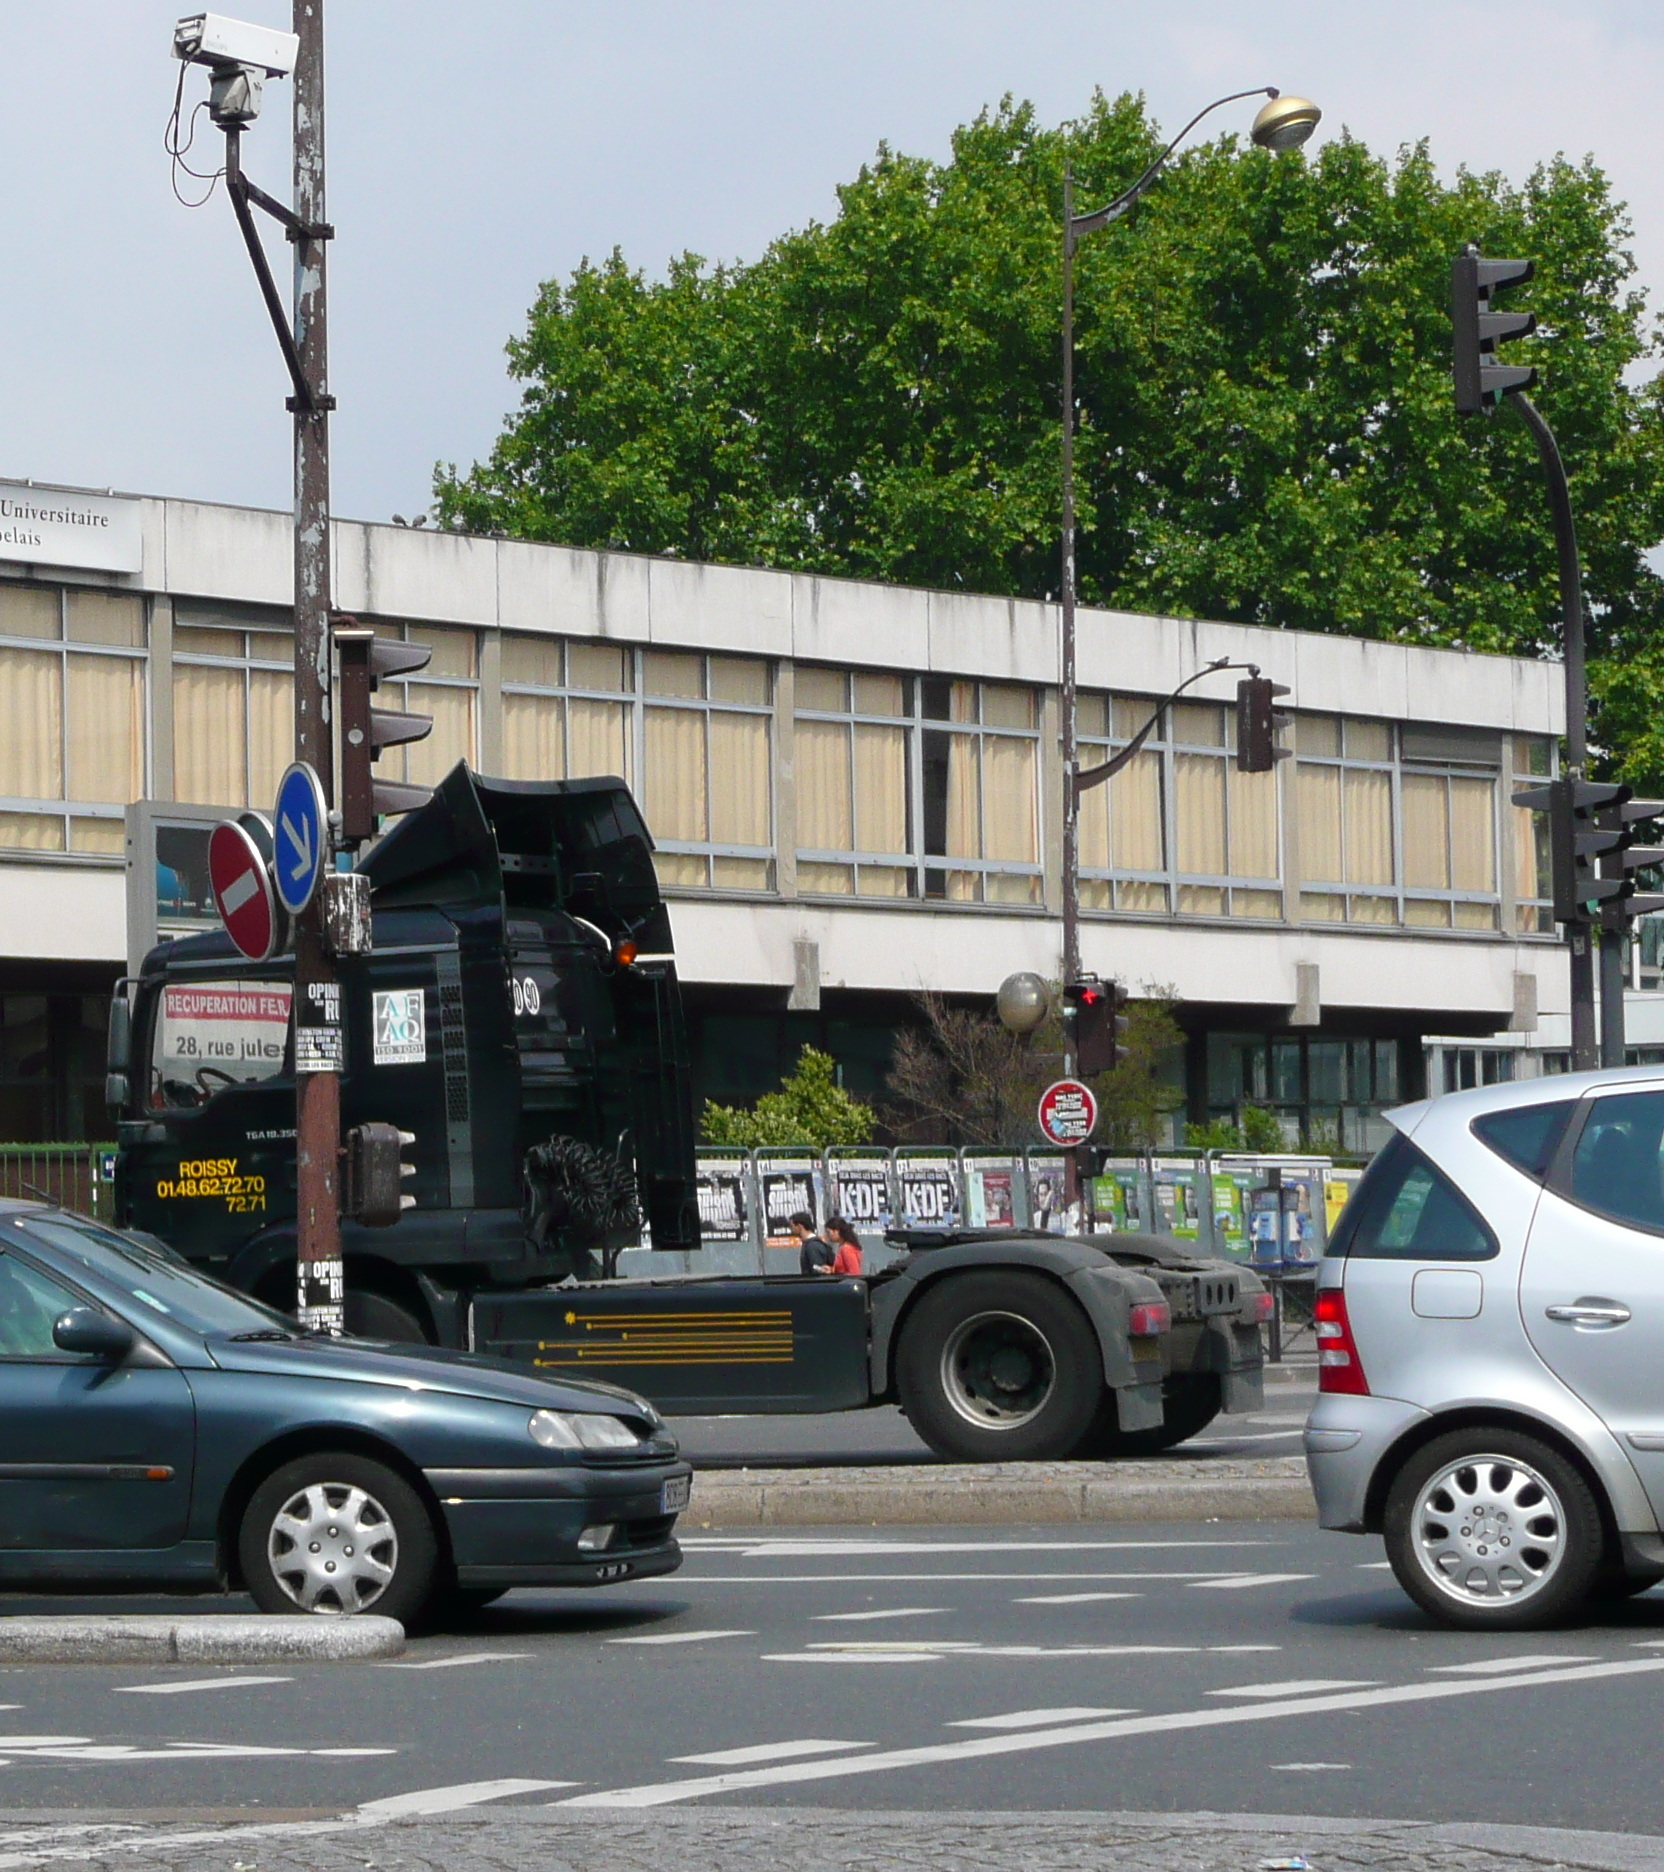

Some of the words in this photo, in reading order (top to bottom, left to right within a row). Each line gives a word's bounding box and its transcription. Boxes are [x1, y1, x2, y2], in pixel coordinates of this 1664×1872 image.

[0, 499, 110, 528] Universitaire
[167, 994, 257, 1016] RECUPERATION
[525, 981, 539, 1011] 90
[207, 1040, 234, 1058] rue
[179, 1158, 238, 1179] ROISSY
[226, 1194, 266, 1214] 72.71
